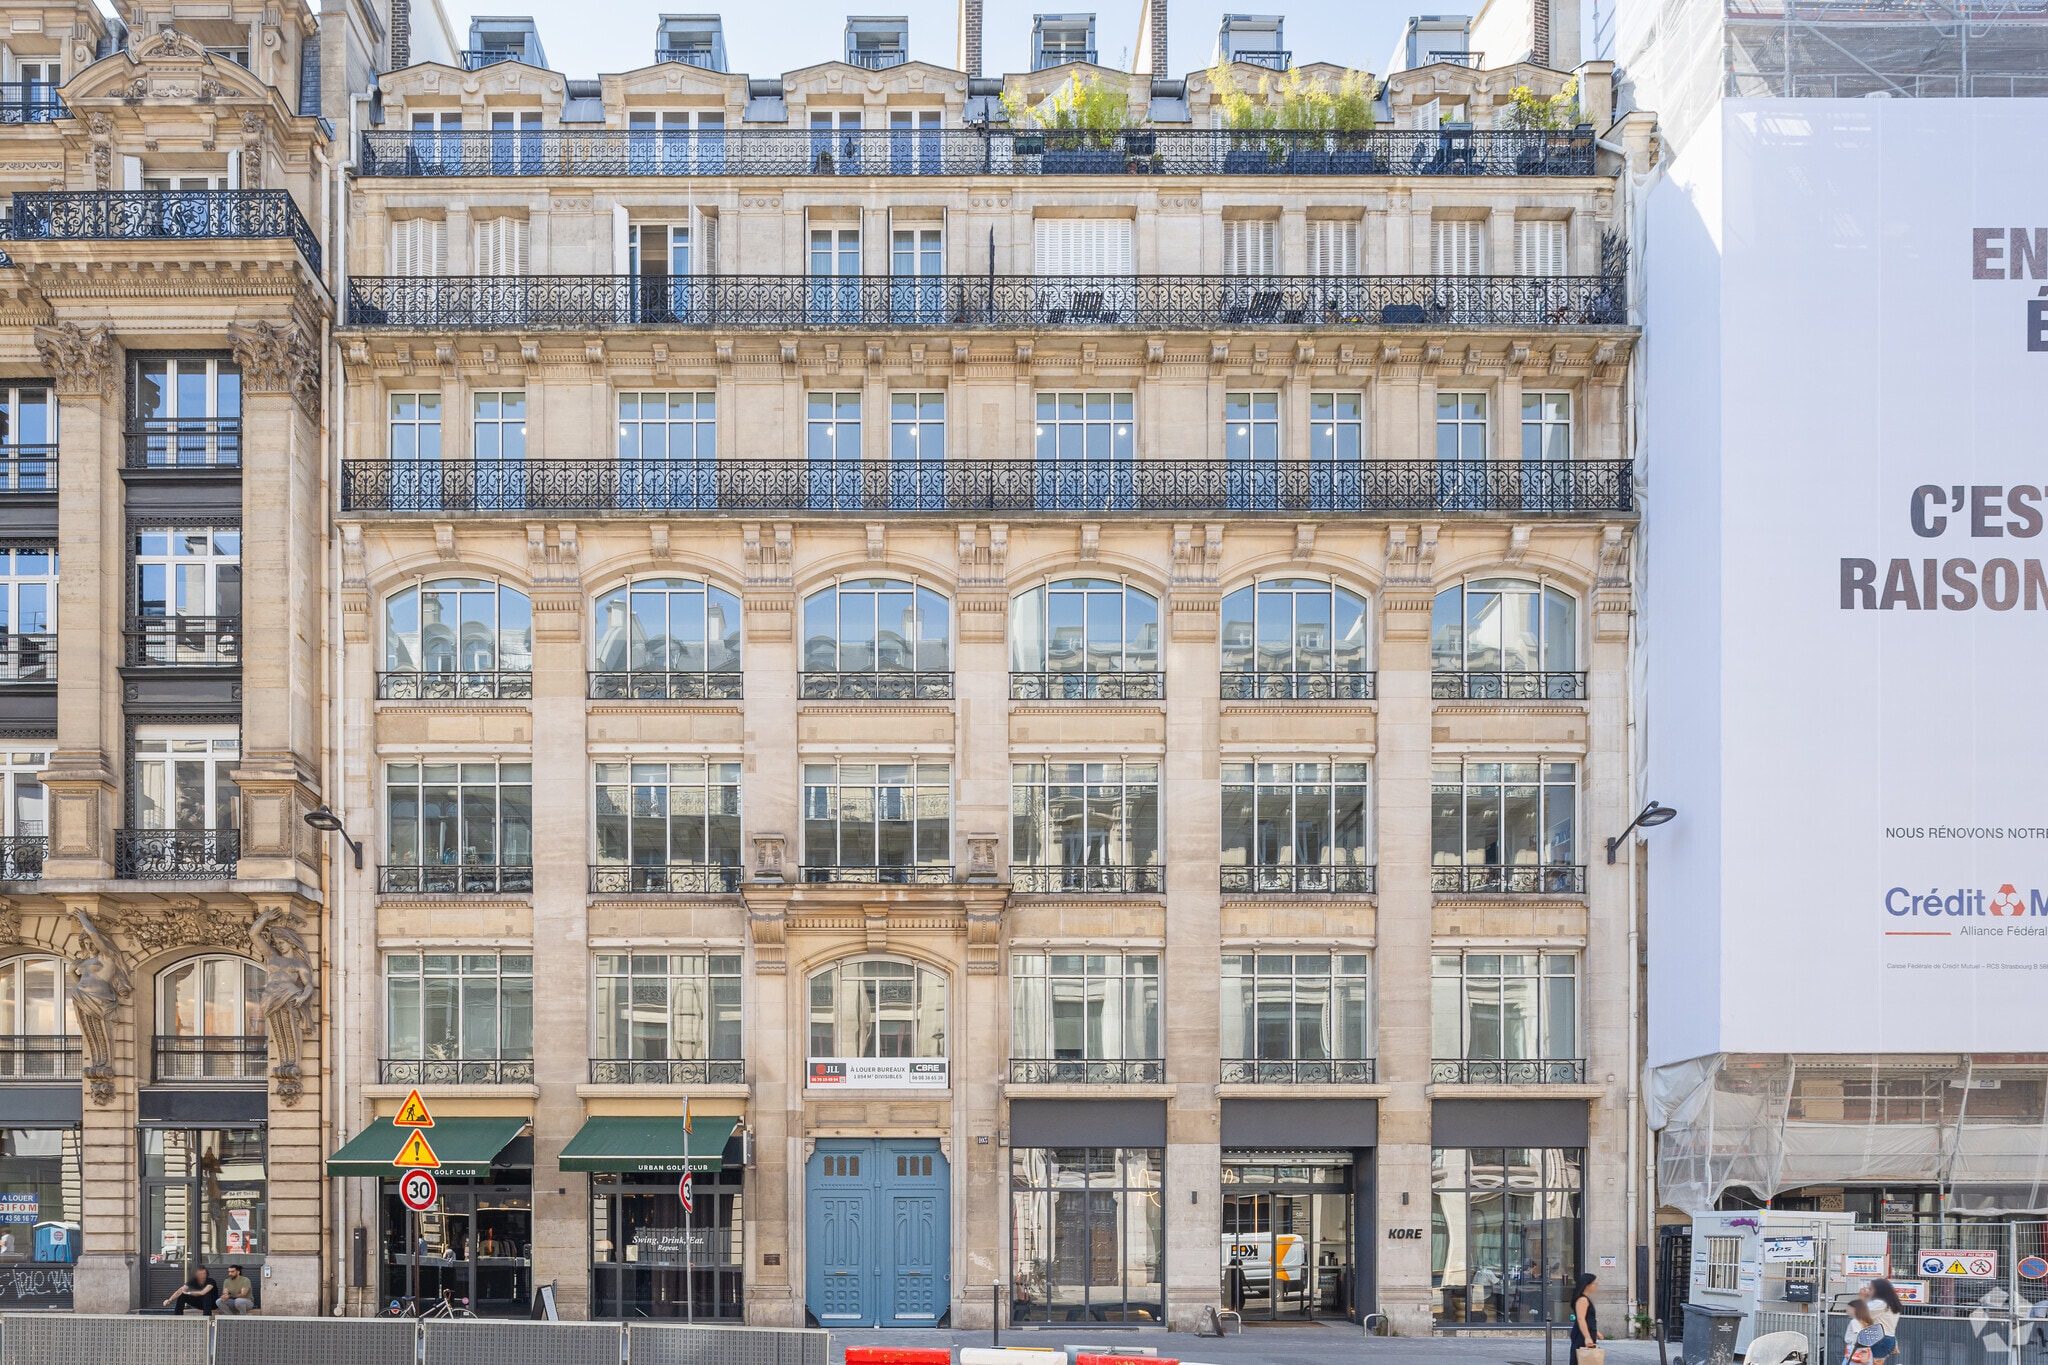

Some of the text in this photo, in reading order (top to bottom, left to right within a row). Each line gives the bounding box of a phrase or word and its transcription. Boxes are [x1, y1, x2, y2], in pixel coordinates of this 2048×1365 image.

[1910, 484, 2048, 538] C'ES
[1885, 827, 1925, 839] NOUS
[1928, 824, 2004, 839] RÉNOVONS
[1885, 886, 1986, 917] Crédit
[1960, 925, 2004, 936] Alliance
[1886, 962, 1906, 970] Caisse
[1907, 962, 1932, 970] Fédérale
[1933, 962, 1941, 970] de
[1942, 962, 1960, 970] Crédit
[2001, 963, 2032, 972] Strasbourg
[826, 1065, 840, 1074] JLL
[916, 1064, 939, 1072] CBRE
[409, 1180, 430, 1199] 30
[1388, 1228, 1423, 1240] KORE
[632, 1235, 704, 1245] Swing, Drink, Eat.
[657, 1244, 680, 1252] Repeat.
